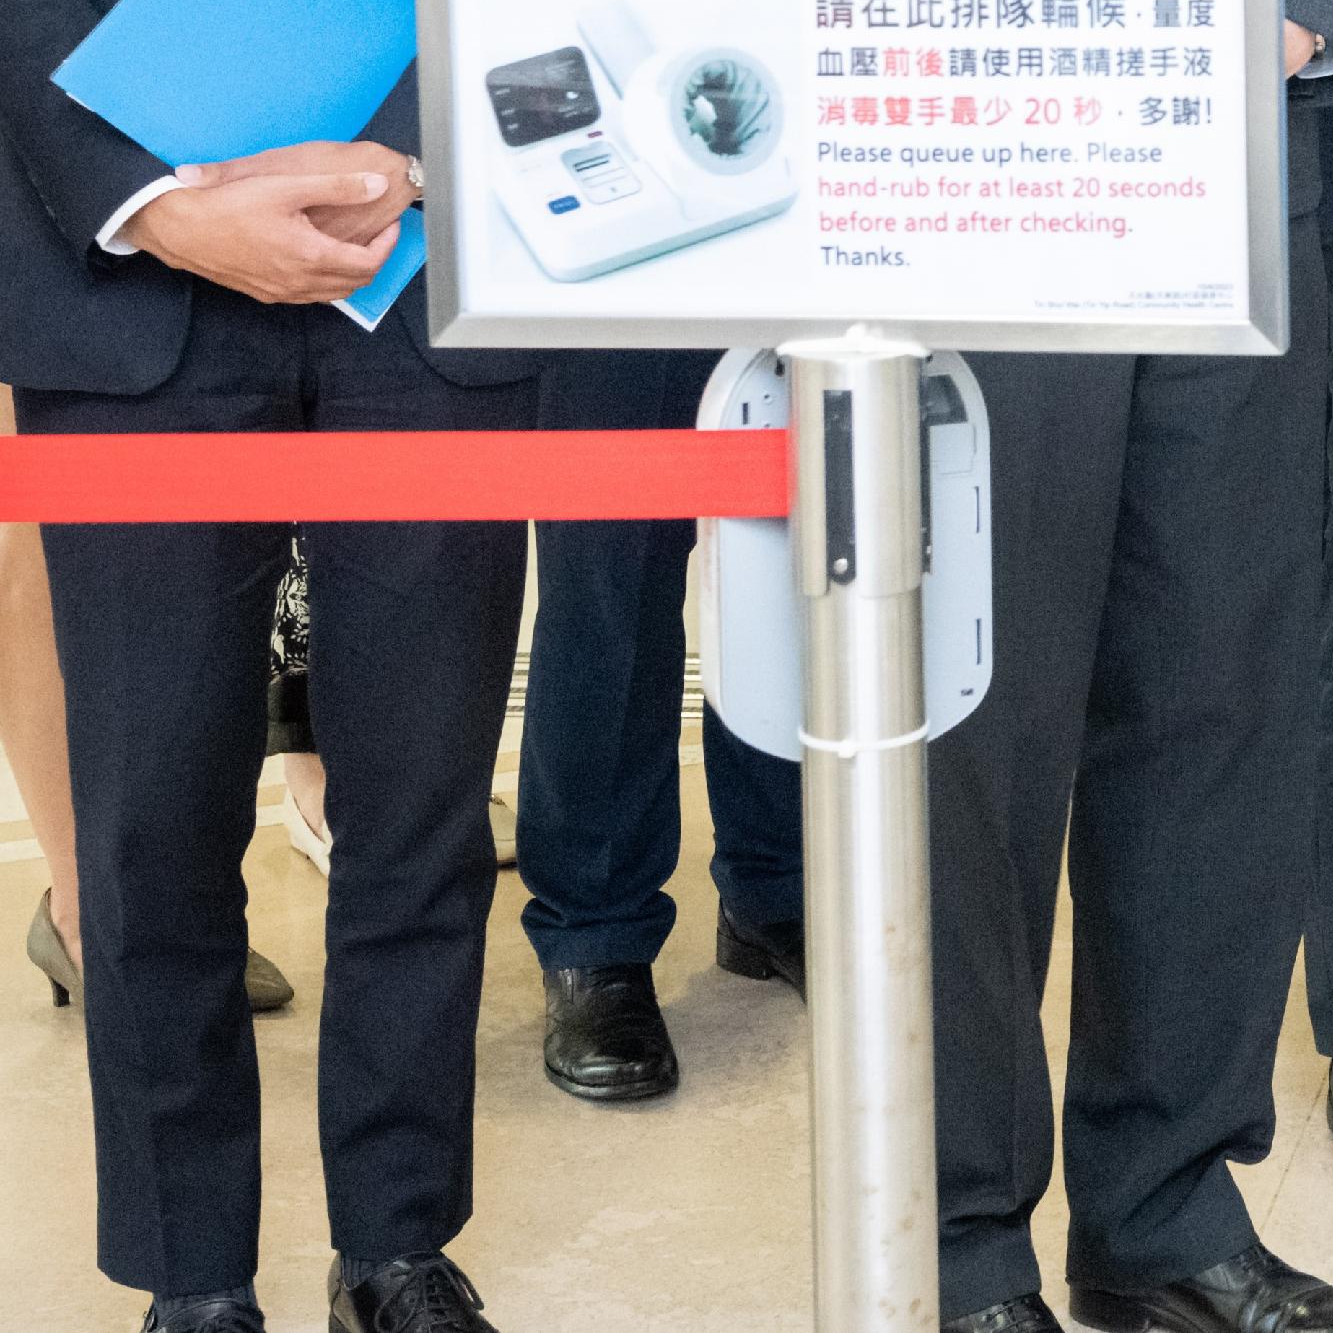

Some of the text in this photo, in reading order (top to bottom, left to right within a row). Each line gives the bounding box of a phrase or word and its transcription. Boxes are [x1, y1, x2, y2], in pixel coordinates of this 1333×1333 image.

[816, 47, 1213, 77] 血壓前後請使用酒精搓手液
[818, 96, 1012, 126] 消毒雙手最少
[1025, 98, 1061, 125] 20
[817, 142, 1163, 168] Please queue up here. Please
[818, 176, 1207, 198] hand-rub for at least 20 seconds
[819, 211, 1133, 239] before and after checking.
[820, 245, 910, 266] Thanks.
